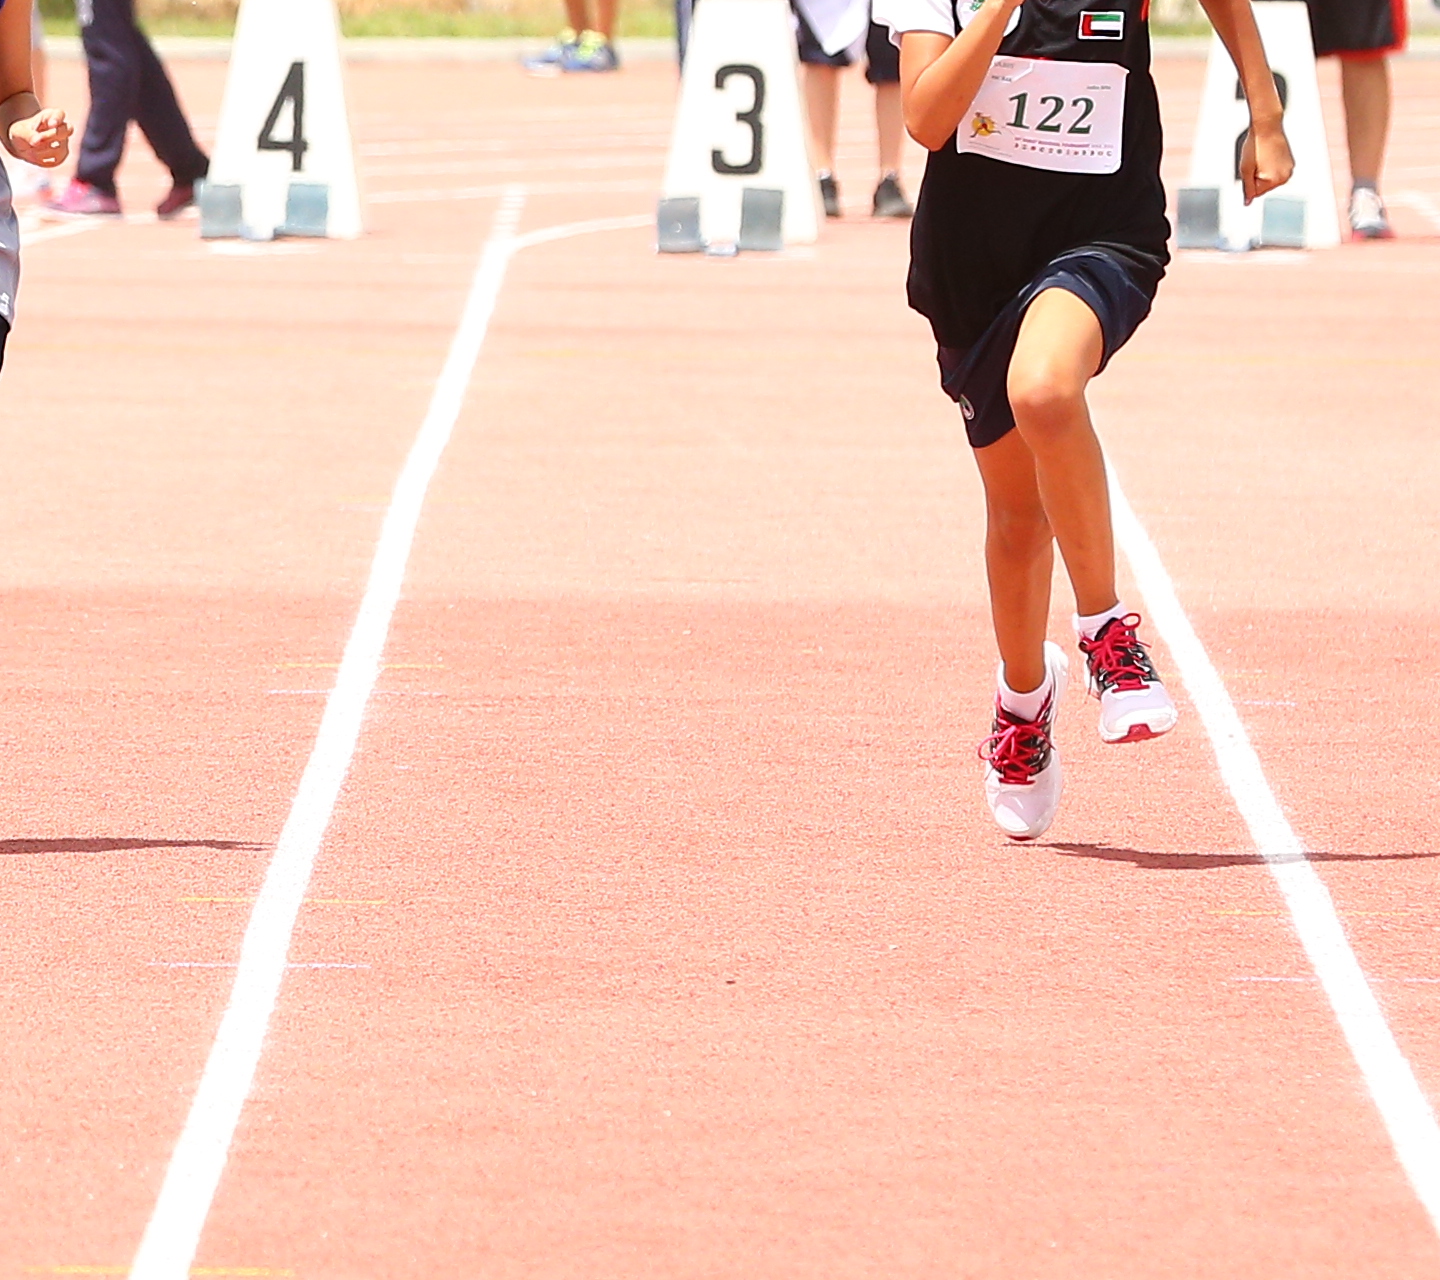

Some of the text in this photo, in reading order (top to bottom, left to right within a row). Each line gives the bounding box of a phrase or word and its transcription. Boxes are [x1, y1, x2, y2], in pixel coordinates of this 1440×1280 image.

[257, 61, 308, 172] 4
[711, 63, 766, 175] 3
[1006, 92, 1096, 135] 122
